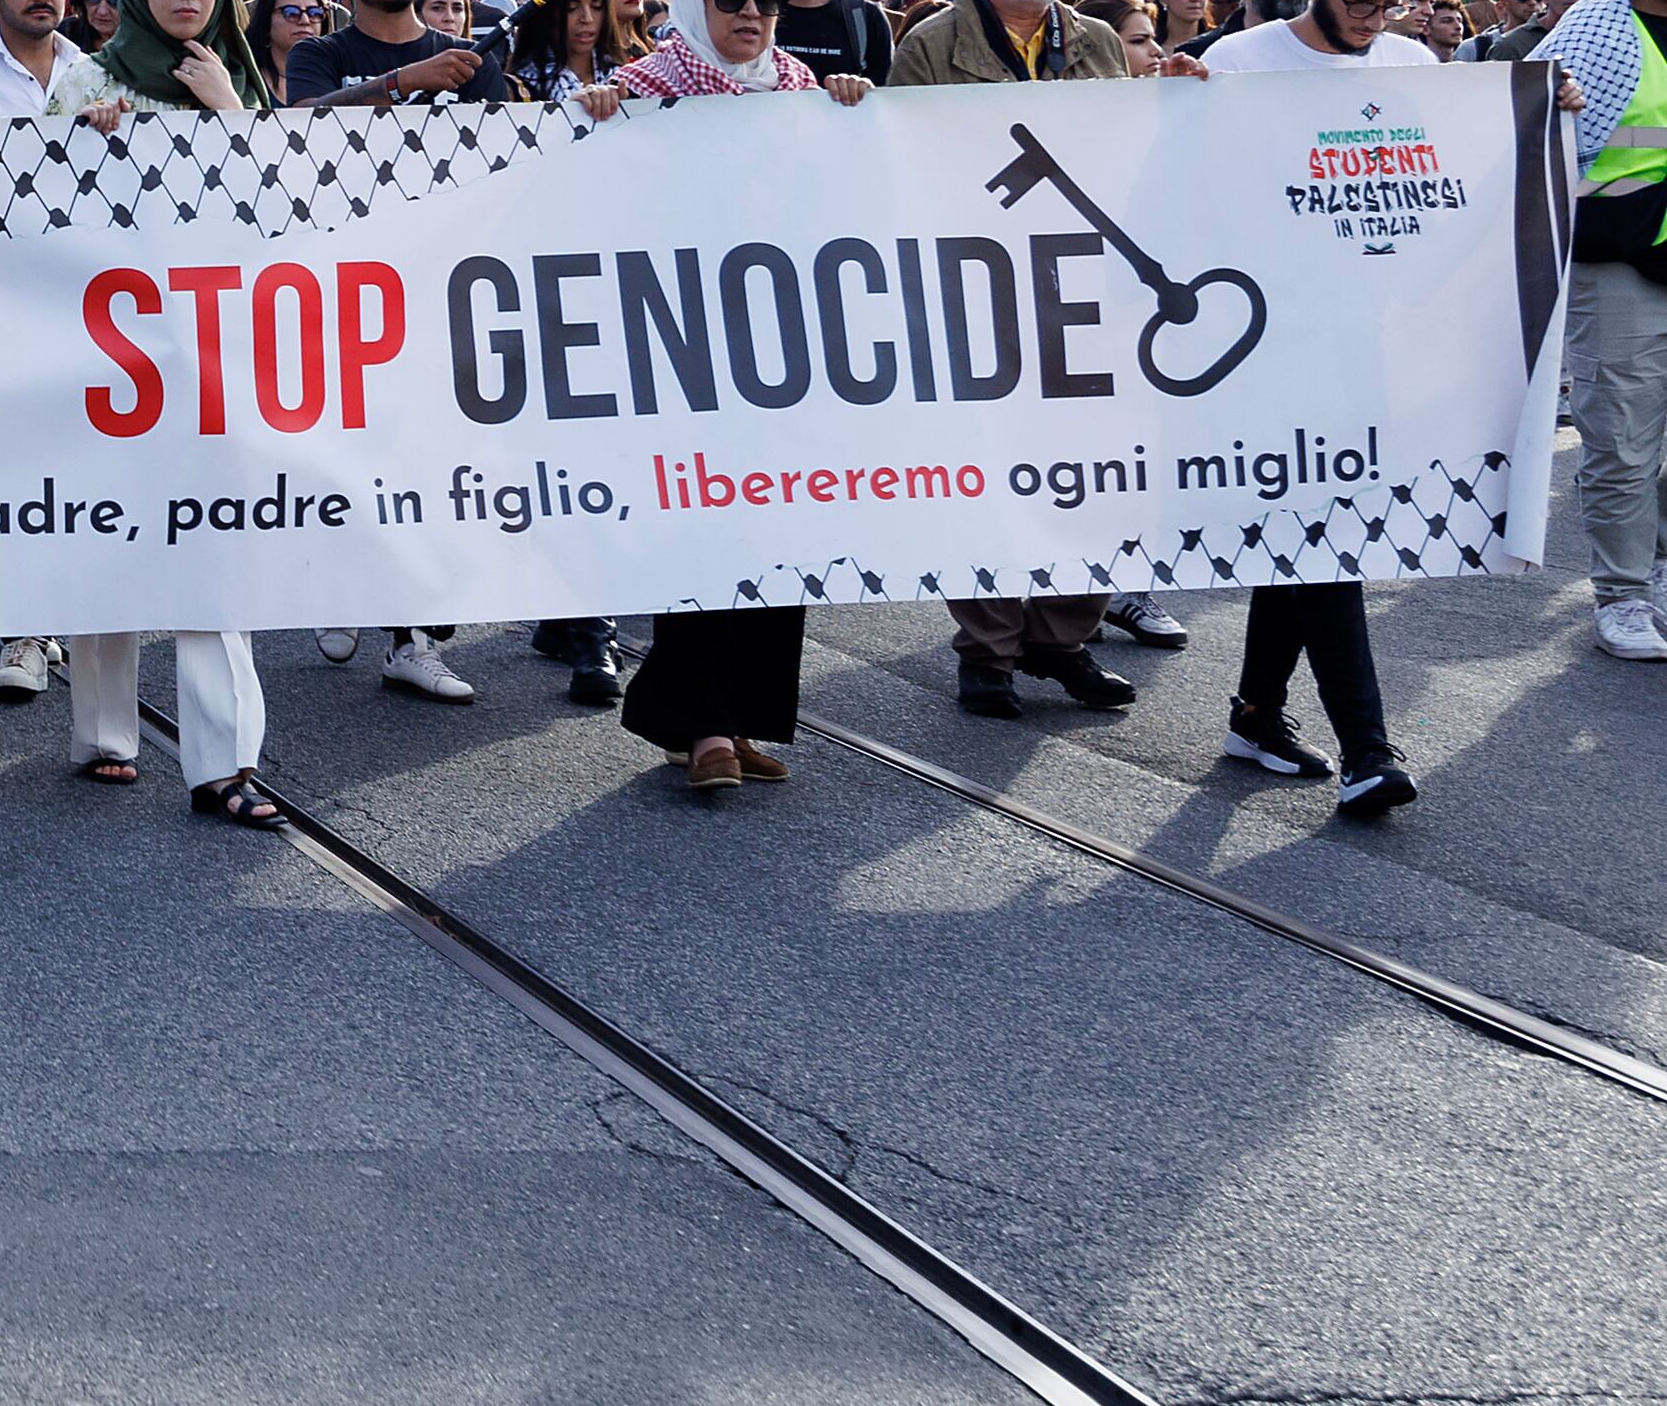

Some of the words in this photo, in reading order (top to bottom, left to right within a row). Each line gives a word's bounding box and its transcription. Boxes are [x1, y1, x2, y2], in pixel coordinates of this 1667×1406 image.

[1317, 128, 1385, 145] MOVIMENTO
[1388, 127, 1426, 142] DEGLI
[1308, 144, 1441, 180] STUDENTI
[1285, 177, 1468, 216] PALESTINESI
[1333, 218, 1354, 239] IN
[1359, 215, 1421, 238] ITALIA
[82, 261, 406, 438] STOP
[447, 232, 1115, 425] GENOCIDE
[167, 473, 353, 546] padre
[375, 478, 424, 525] in
[447, 461, 632, 535] figlio,
[653, 451, 987, 511] libereremo
[1008, 444, 1148, 511] ogni
[1176, 426, 1380, 501] miglio!
